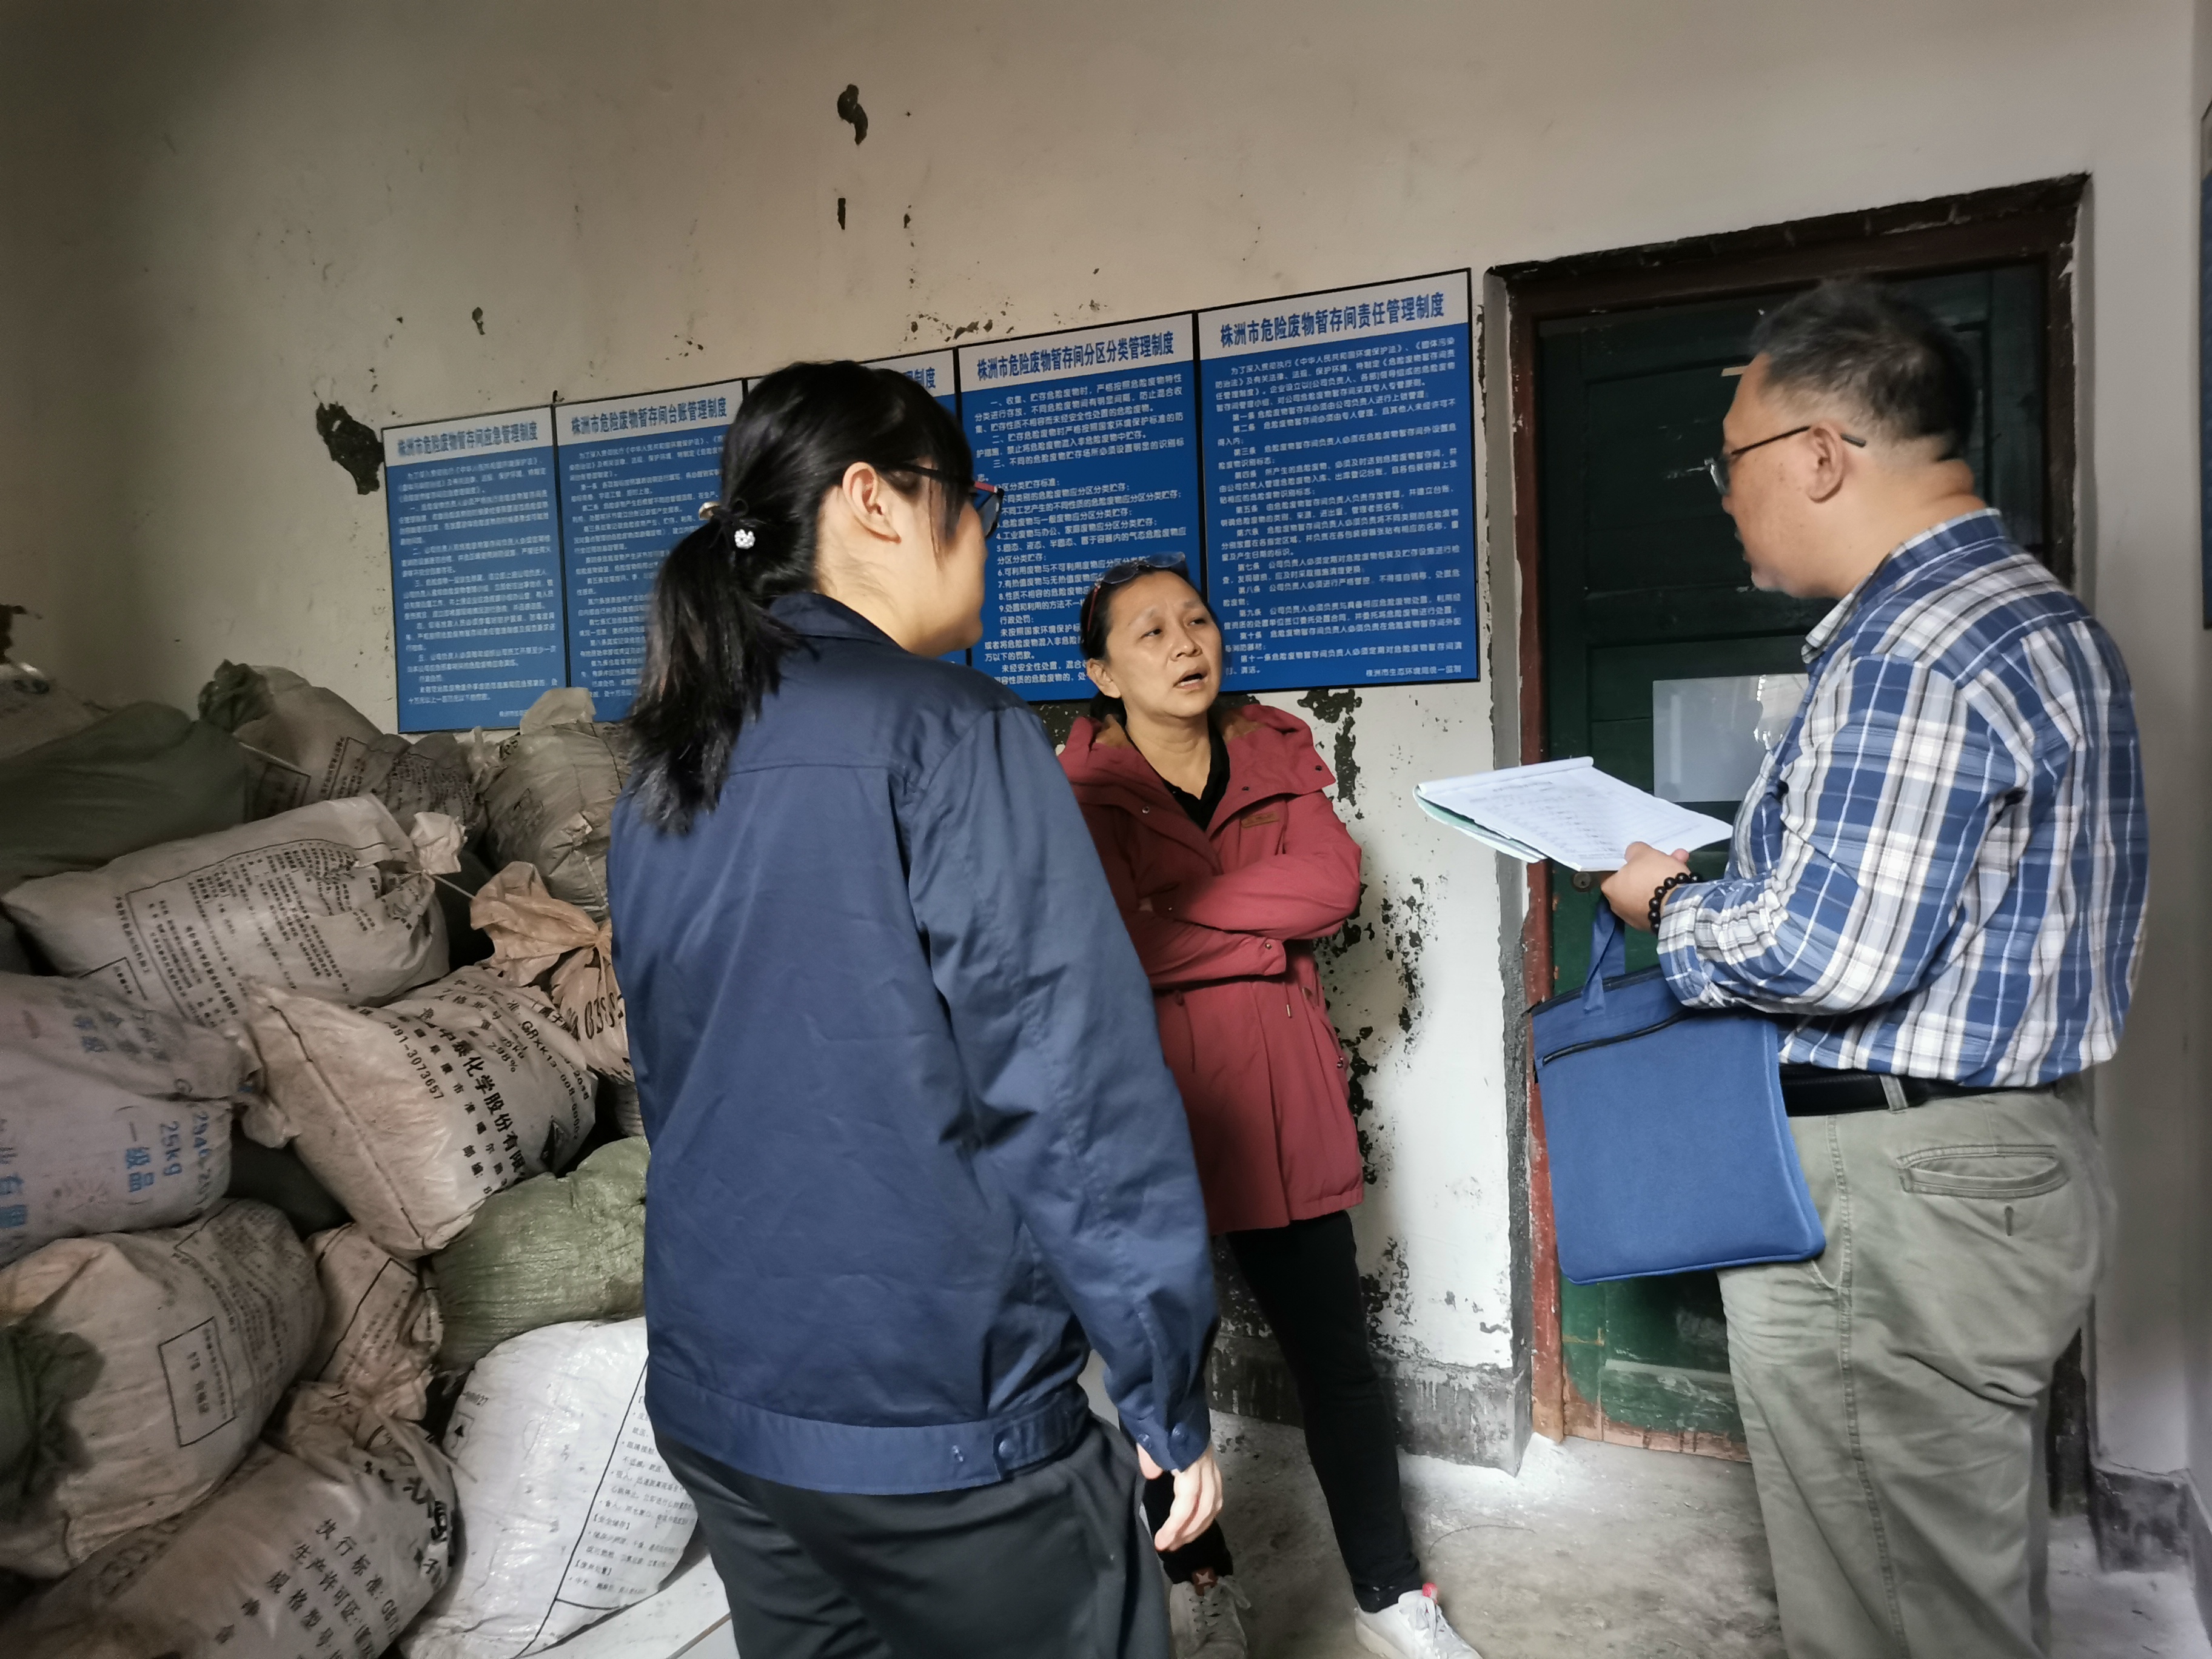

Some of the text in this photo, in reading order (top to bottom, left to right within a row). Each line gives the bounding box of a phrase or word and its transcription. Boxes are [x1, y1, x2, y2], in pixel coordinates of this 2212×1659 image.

[1219, 292, 1444, 348] 株洲市危险废物暂存间责任管理制度
[976, 330, 1174, 382] 株洲市危险废物暂存间分区分类管理制度
